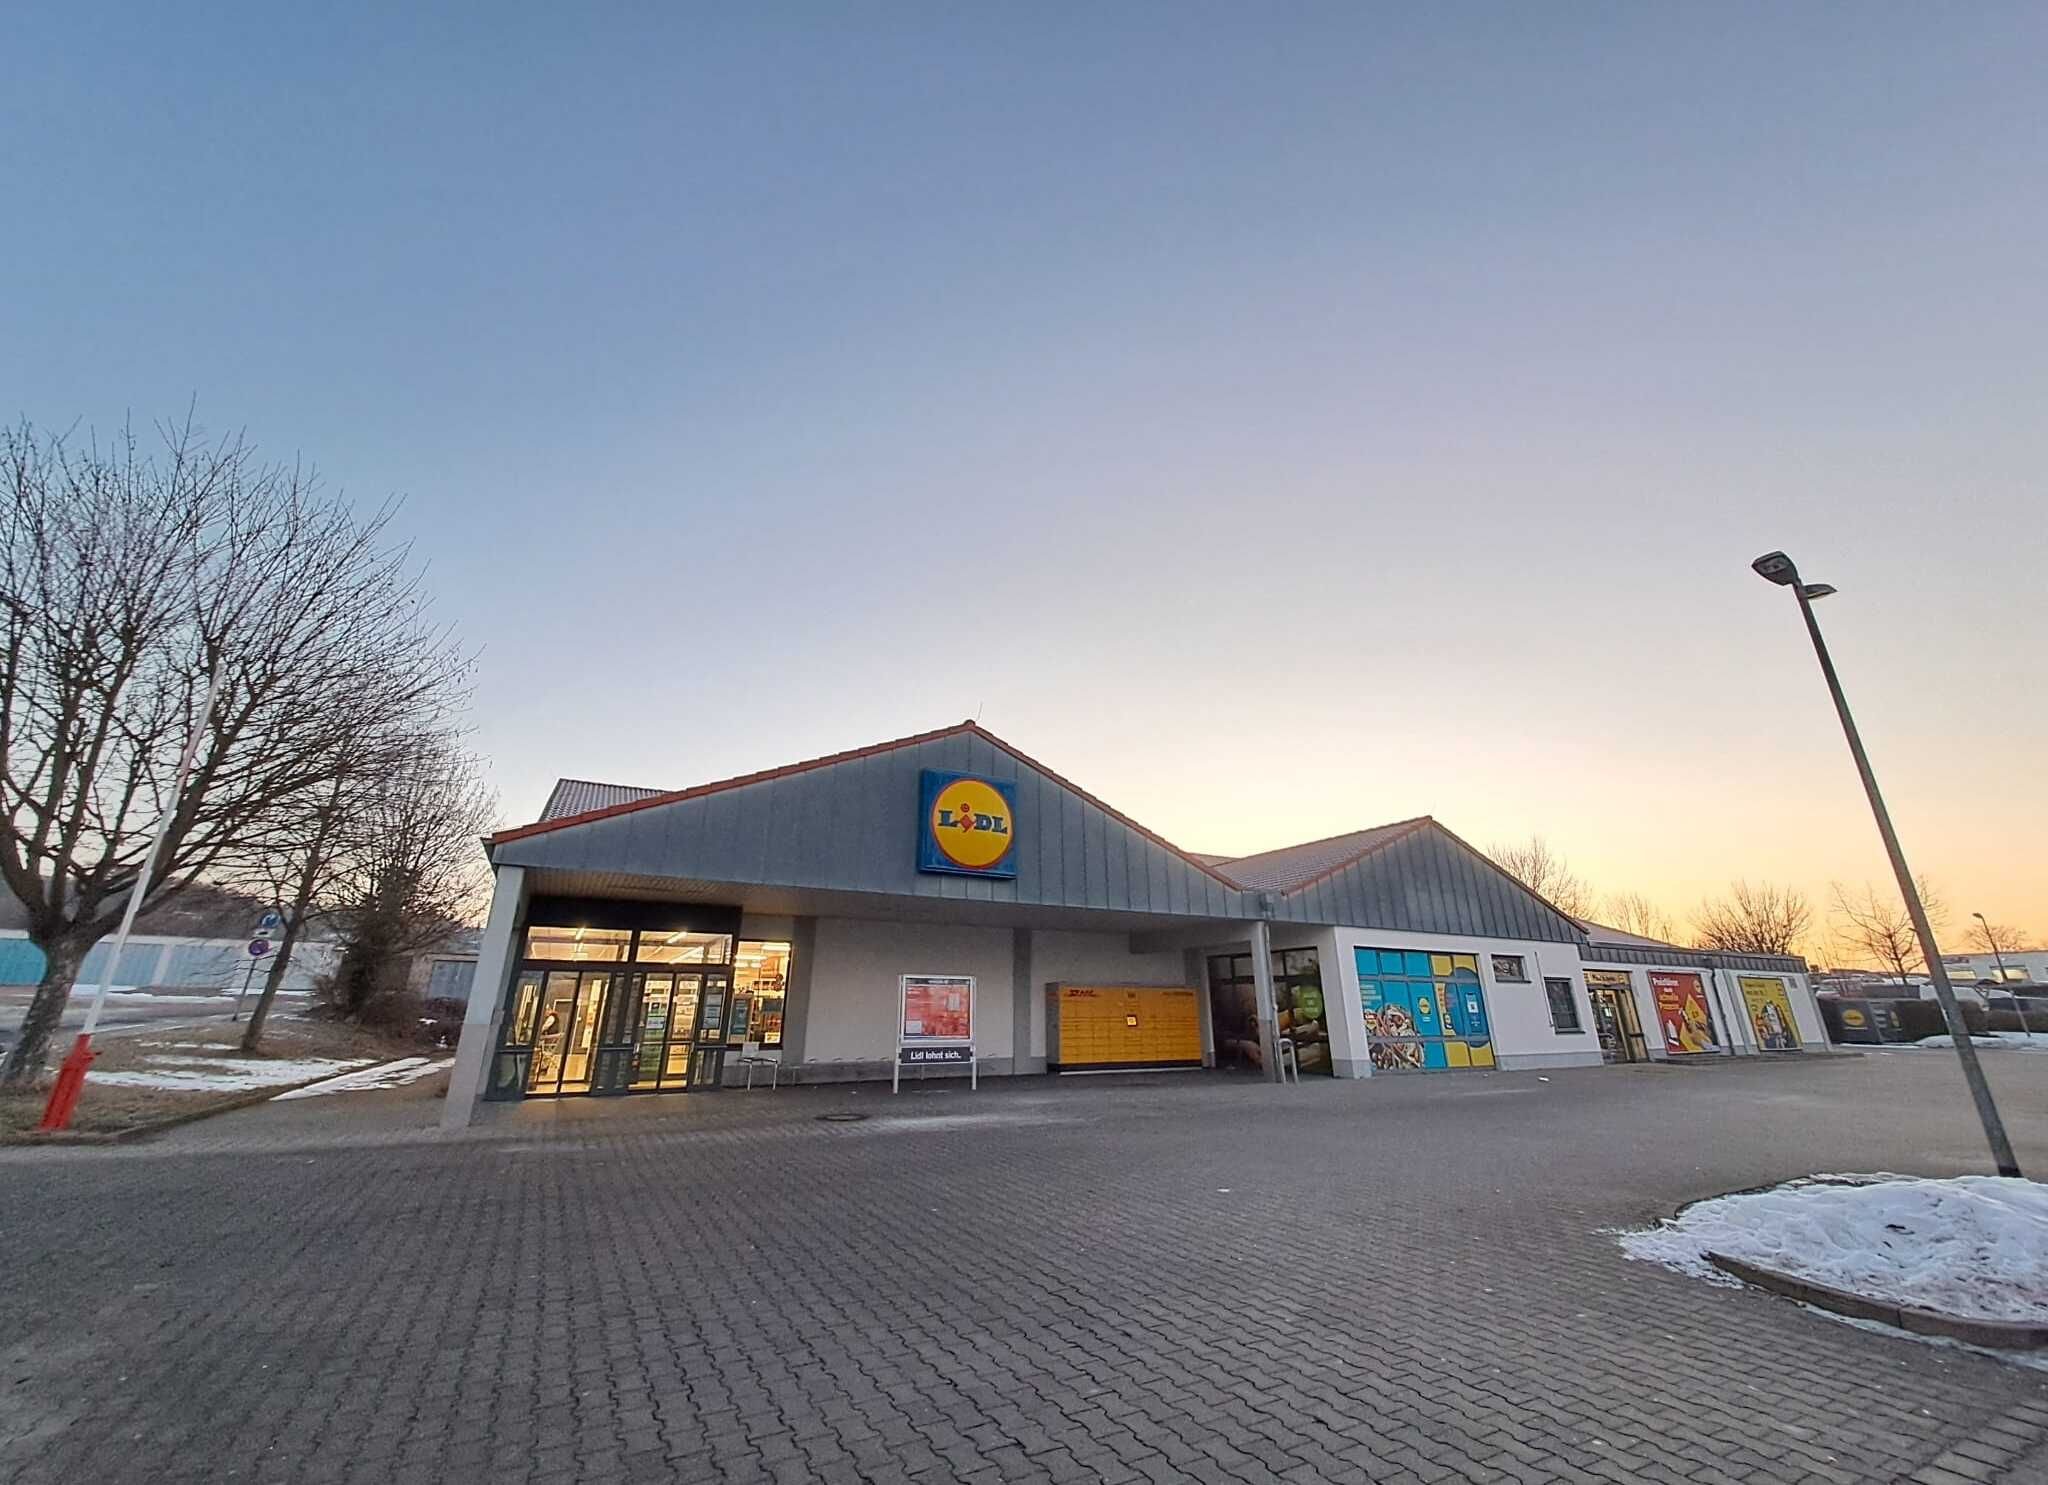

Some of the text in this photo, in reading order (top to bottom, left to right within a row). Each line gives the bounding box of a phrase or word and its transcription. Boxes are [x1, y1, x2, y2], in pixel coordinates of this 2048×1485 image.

[910, 1050, 962, 1060] Lidl lohnt sich.
